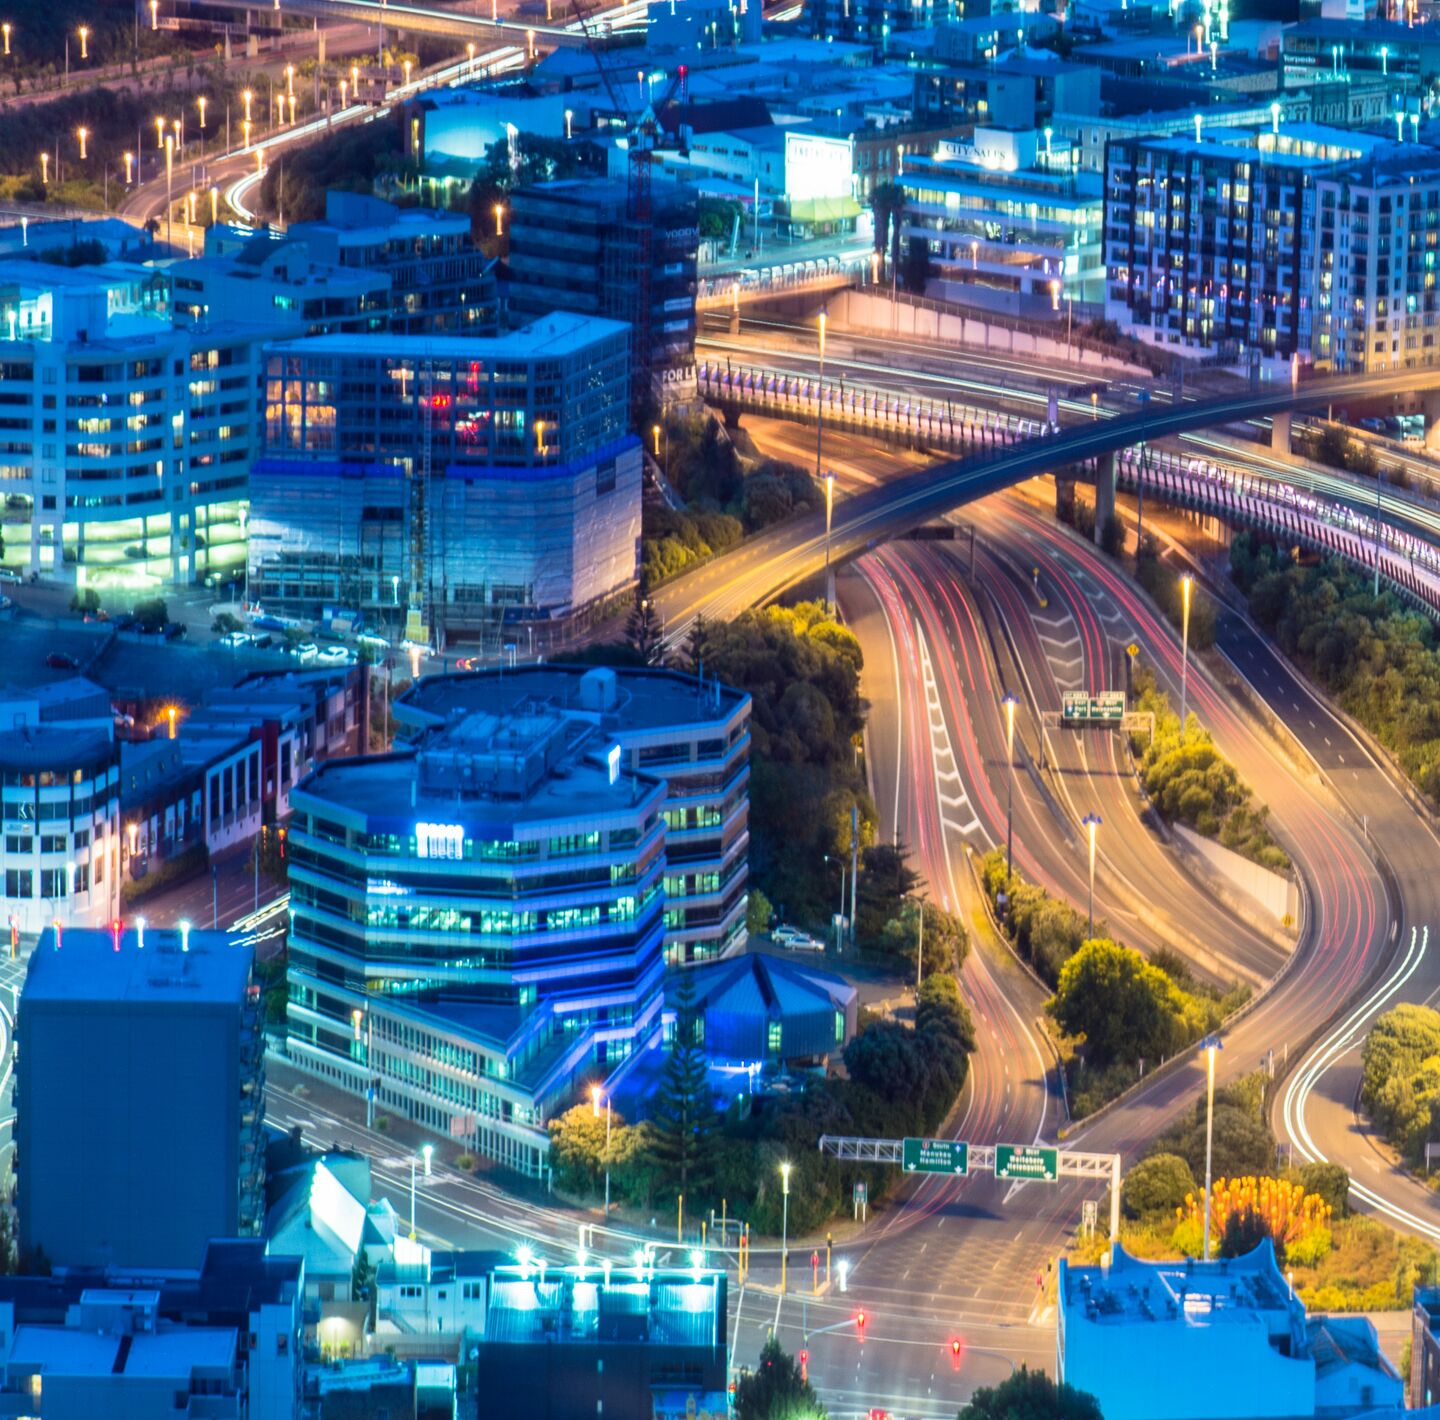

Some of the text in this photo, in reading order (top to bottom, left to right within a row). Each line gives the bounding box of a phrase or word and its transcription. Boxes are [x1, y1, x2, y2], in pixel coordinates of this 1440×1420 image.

[946, 143, 969, 156] CITY
[662, 368, 683, 383] FOR
[919, 1157, 951, 1166] Hamilton
